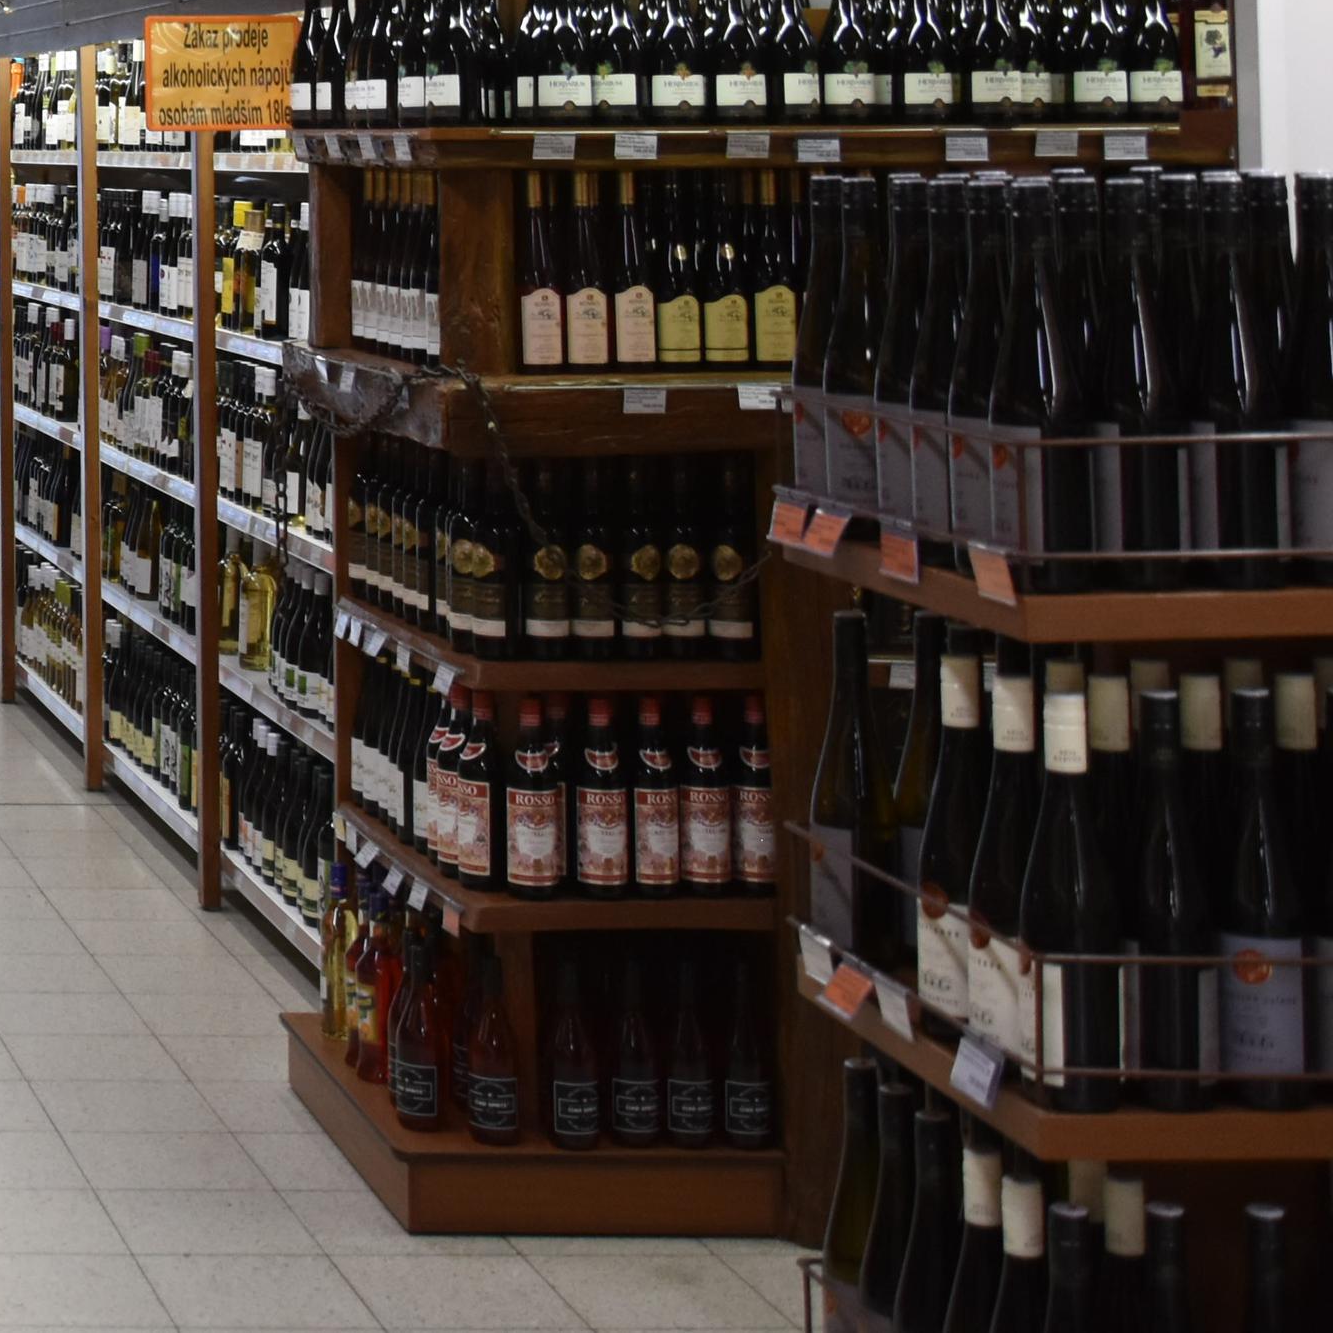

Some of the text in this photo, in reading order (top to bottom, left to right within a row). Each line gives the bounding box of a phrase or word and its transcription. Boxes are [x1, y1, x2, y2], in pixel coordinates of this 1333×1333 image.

[222, 22, 269, 54] prodeje
[162, 61, 246, 93] alkoholických
[159, 98, 293, 126] osobám mladším 18le
[515, 793, 555, 806] ROSSO
